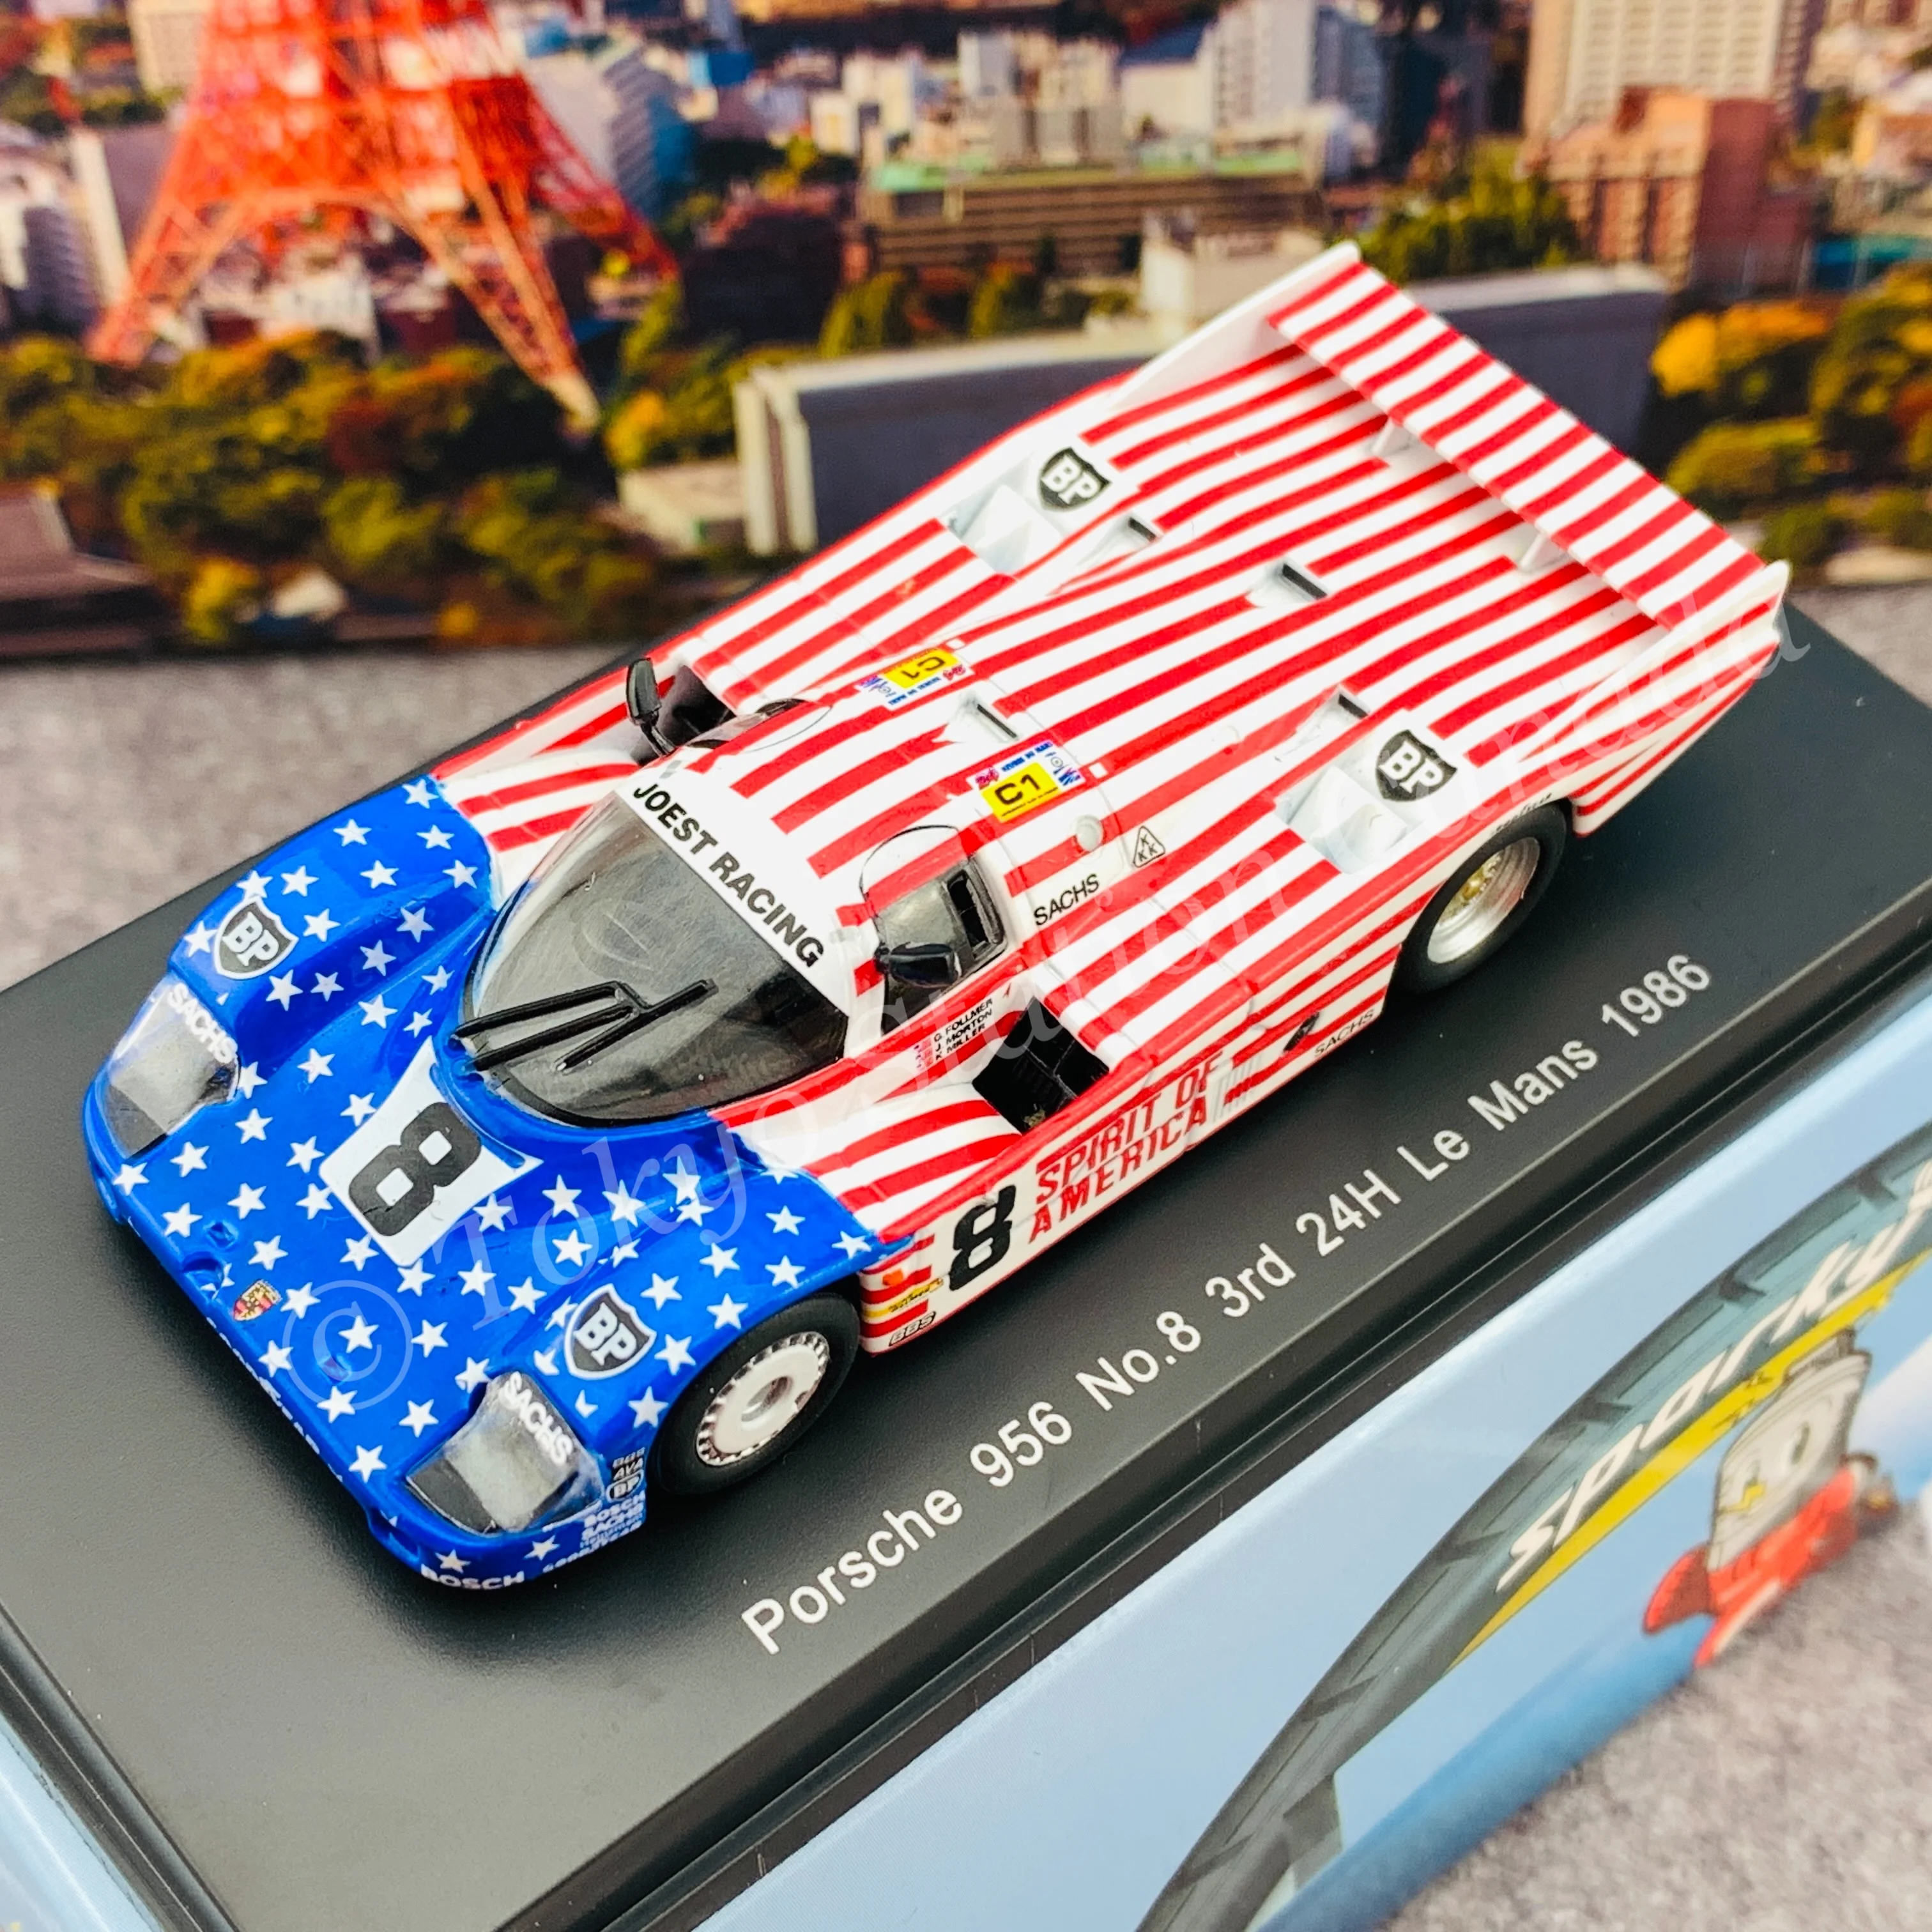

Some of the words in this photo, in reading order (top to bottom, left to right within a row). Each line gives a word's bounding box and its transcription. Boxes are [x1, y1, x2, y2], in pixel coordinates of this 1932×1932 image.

[1041, 459, 1098, 505] BP
[900, 657, 945, 679] C1
[995, 774, 1040, 805] C1
[1384, 745, 1445, 793] BP
[633, 784, 717, 854] JOEST
[709, 852, 824, 967] RACING
[1034, 873, 1100, 926] SACHS
[222, 912, 280, 966] BP
[168, 983, 238, 1064] SACHS
[946, 998, 993, 1034] FOLLMER
[946, 1009, 992, 1046] MORTON
[1315, 1008, 1374, 1054] SACHS
[1036, 1092, 1161, 1204] SPIRIT
[1175, 1052, 1223, 1109] OF
[349, 1102, 481, 1236] 8
[1029, 1095, 1207, 1244] AMERICA
[948, 1185, 1016, 1291] 8
[741, 1489, 963, 1655] Porsche
[969, 1401, 1073, 1488] 956
[1075, 1310, 1202, 1411] No.8
[1205, 1243, 1296, 1318] 3rd
[1296, 1169, 1402, 1257] 24H
[1397, 1128, 1471, 1181] Le
[1468, 1039, 1599, 1131] Mans
[1601, 954, 1712, 1037] 1986
[574, 1303, 637, 1365] BP
[499, 1372, 573, 1466] SACHS
[420, 1563, 525, 1590] BOSCH
